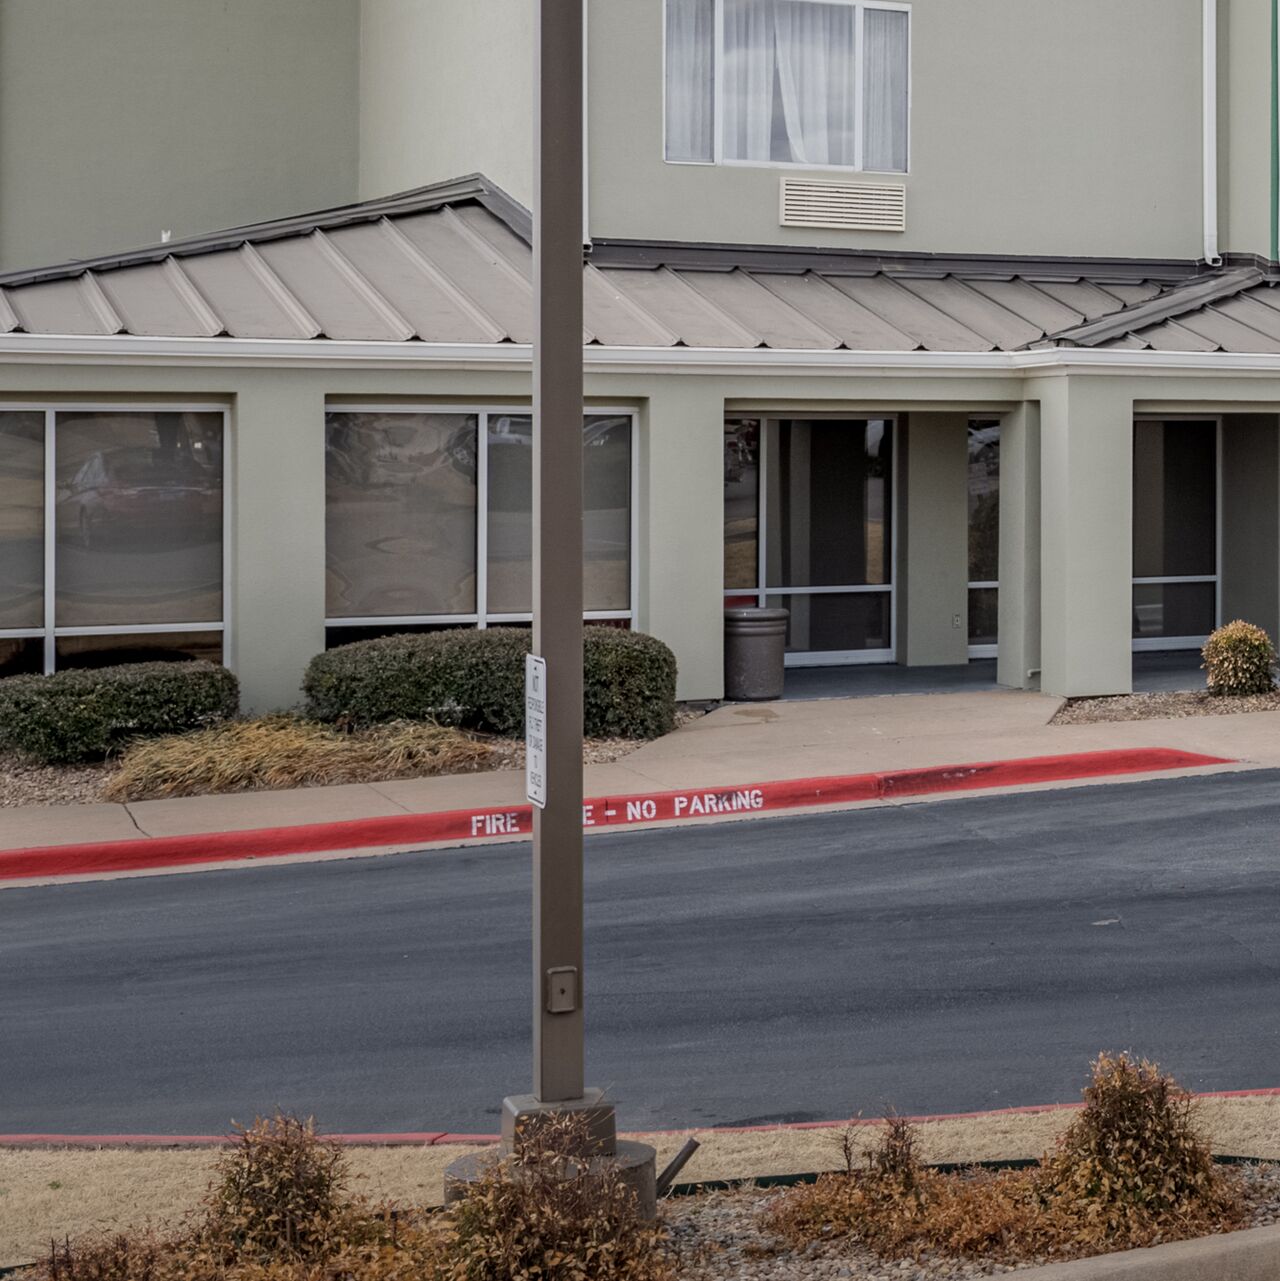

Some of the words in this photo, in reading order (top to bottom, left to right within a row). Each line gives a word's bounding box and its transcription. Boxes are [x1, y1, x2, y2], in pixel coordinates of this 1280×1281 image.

[471, 812, 520, 836] FIRE
[626, 800, 657, 821] NO
[674, 789, 763, 816] PARKING
